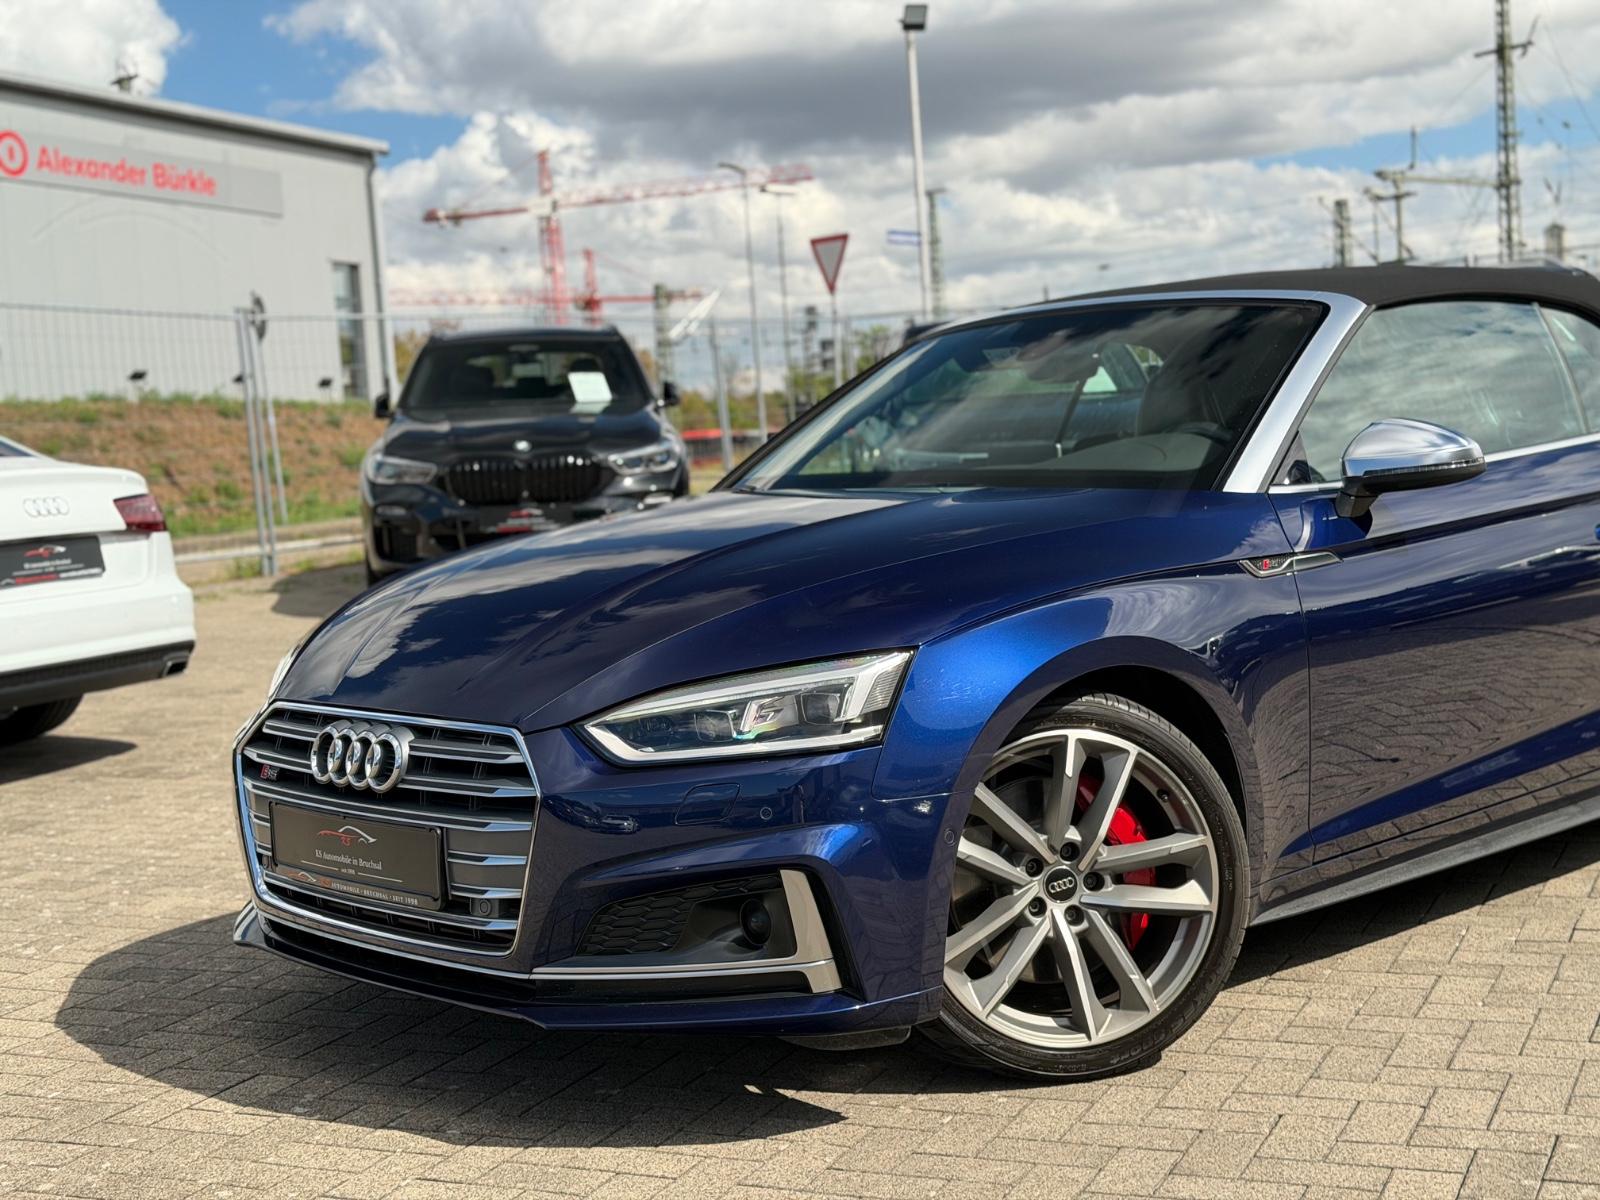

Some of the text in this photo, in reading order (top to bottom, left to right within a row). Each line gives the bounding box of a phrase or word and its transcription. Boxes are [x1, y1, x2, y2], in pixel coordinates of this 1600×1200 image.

[37, 146, 217, 196] Alexander Bürkle
[352, 857, 358, 865] in
[359, 858, 382, 870] Bruchsal
